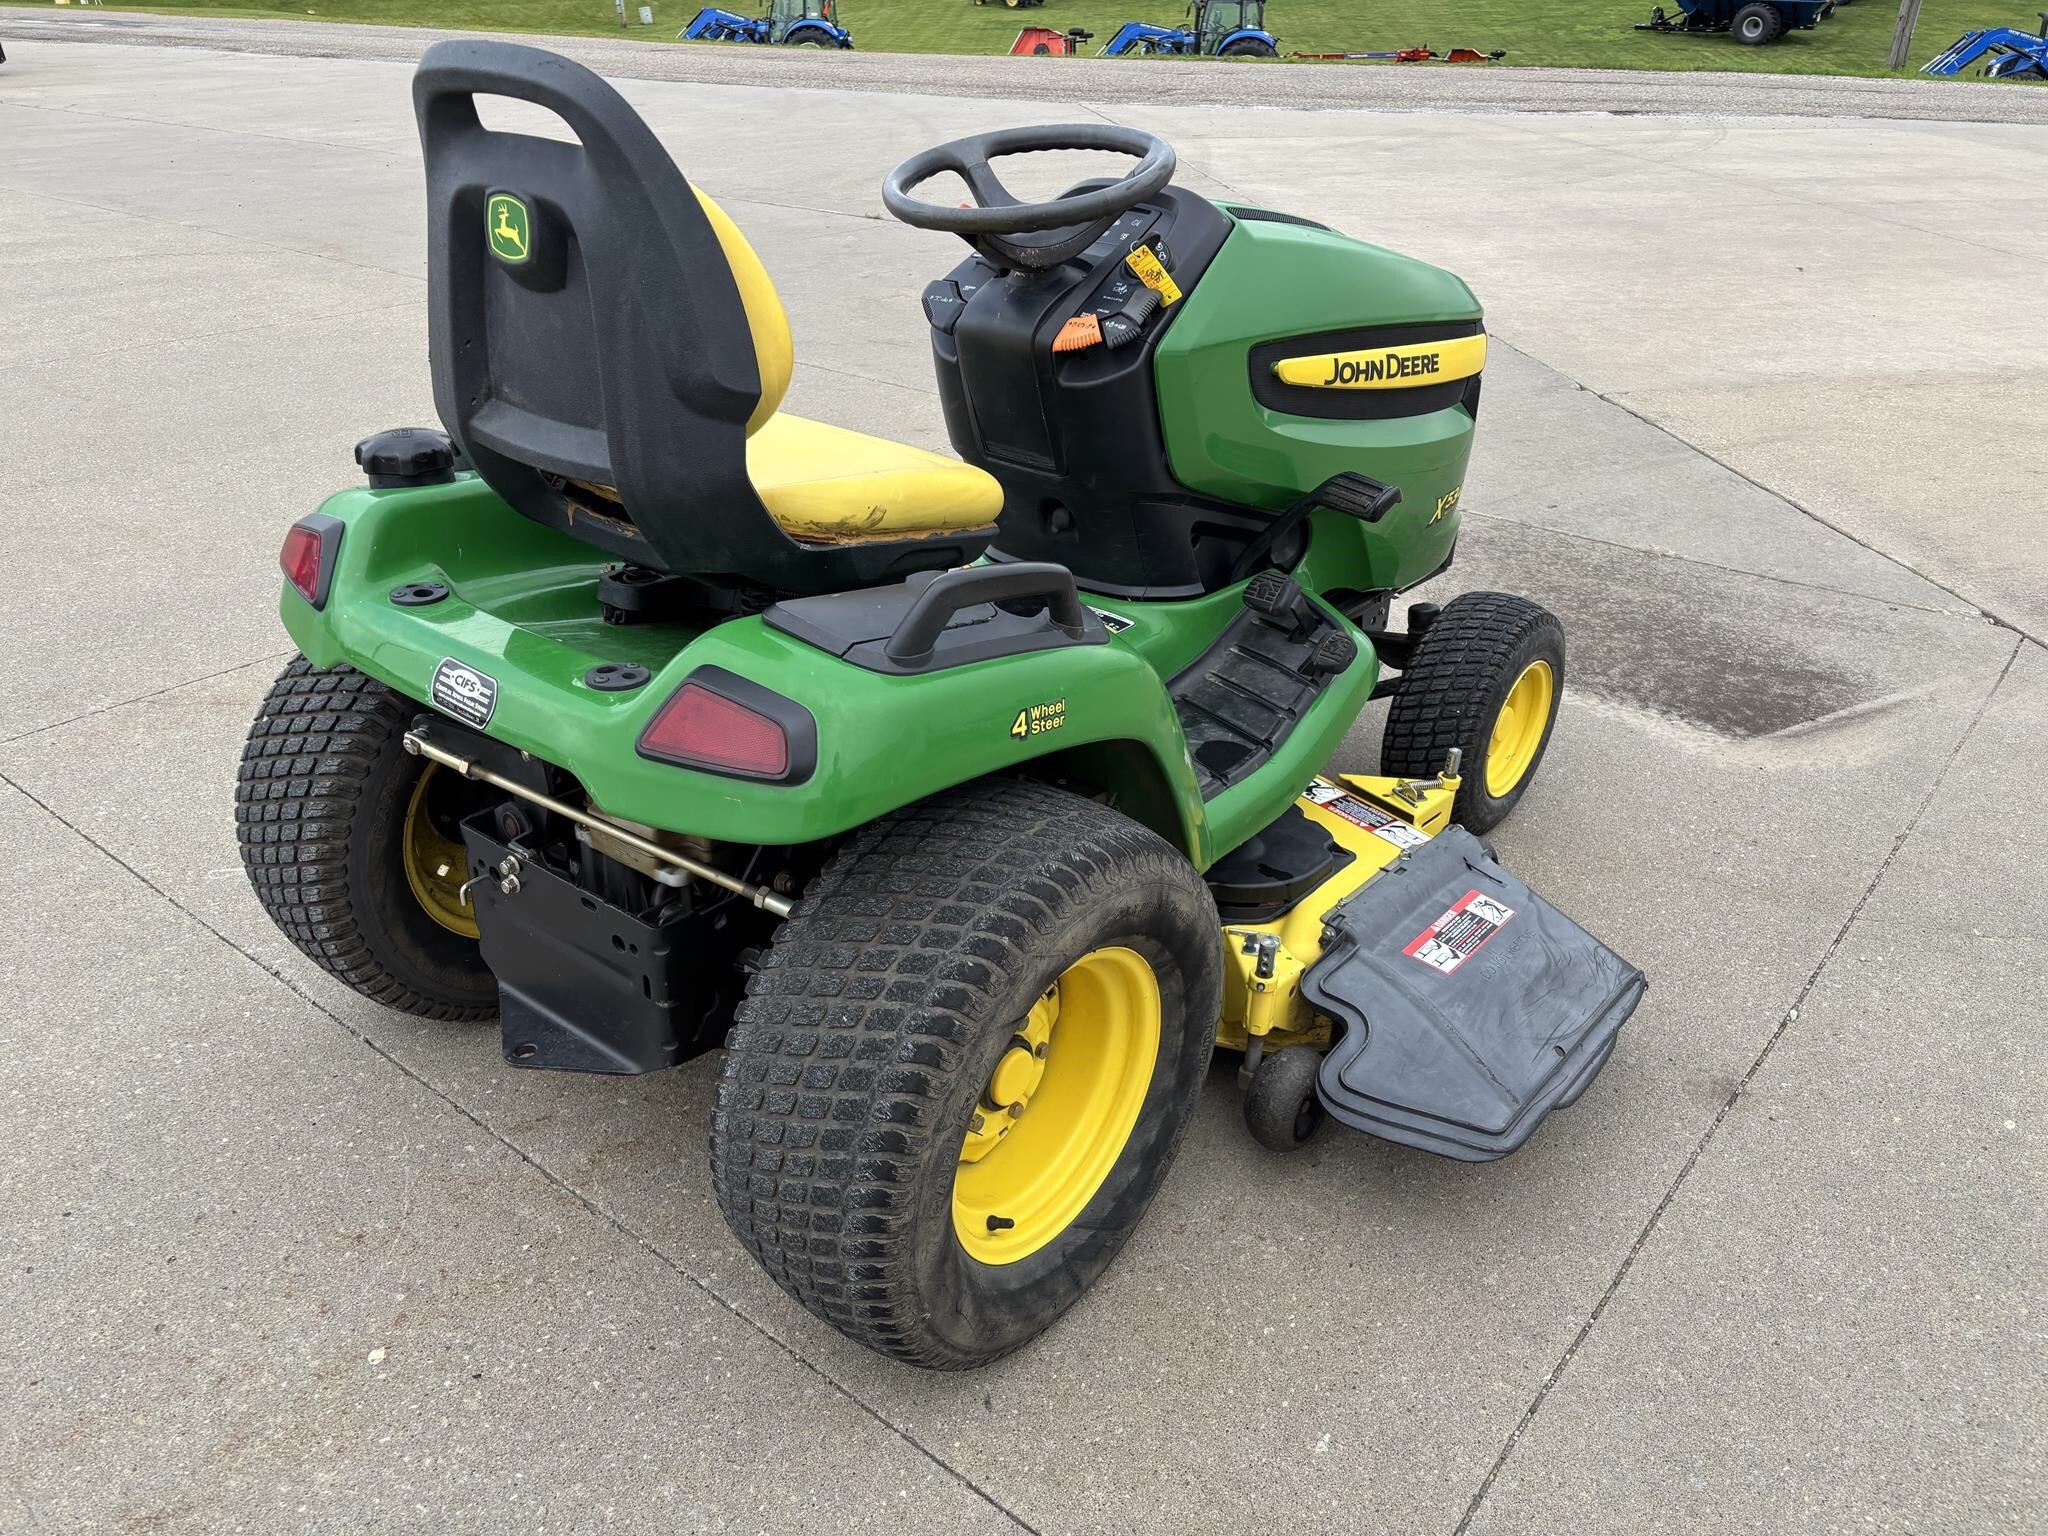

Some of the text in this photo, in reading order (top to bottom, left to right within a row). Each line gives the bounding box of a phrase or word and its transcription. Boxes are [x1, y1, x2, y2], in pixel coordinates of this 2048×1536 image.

[1324, 353, 1440, 386] JOHN DEERE
[455, 675, 477, 692] CIFS
[1030, 698, 1065, 720] Wheel
[1011, 710, 1028, 737] 4
[1031, 715, 1065, 734] Steer
